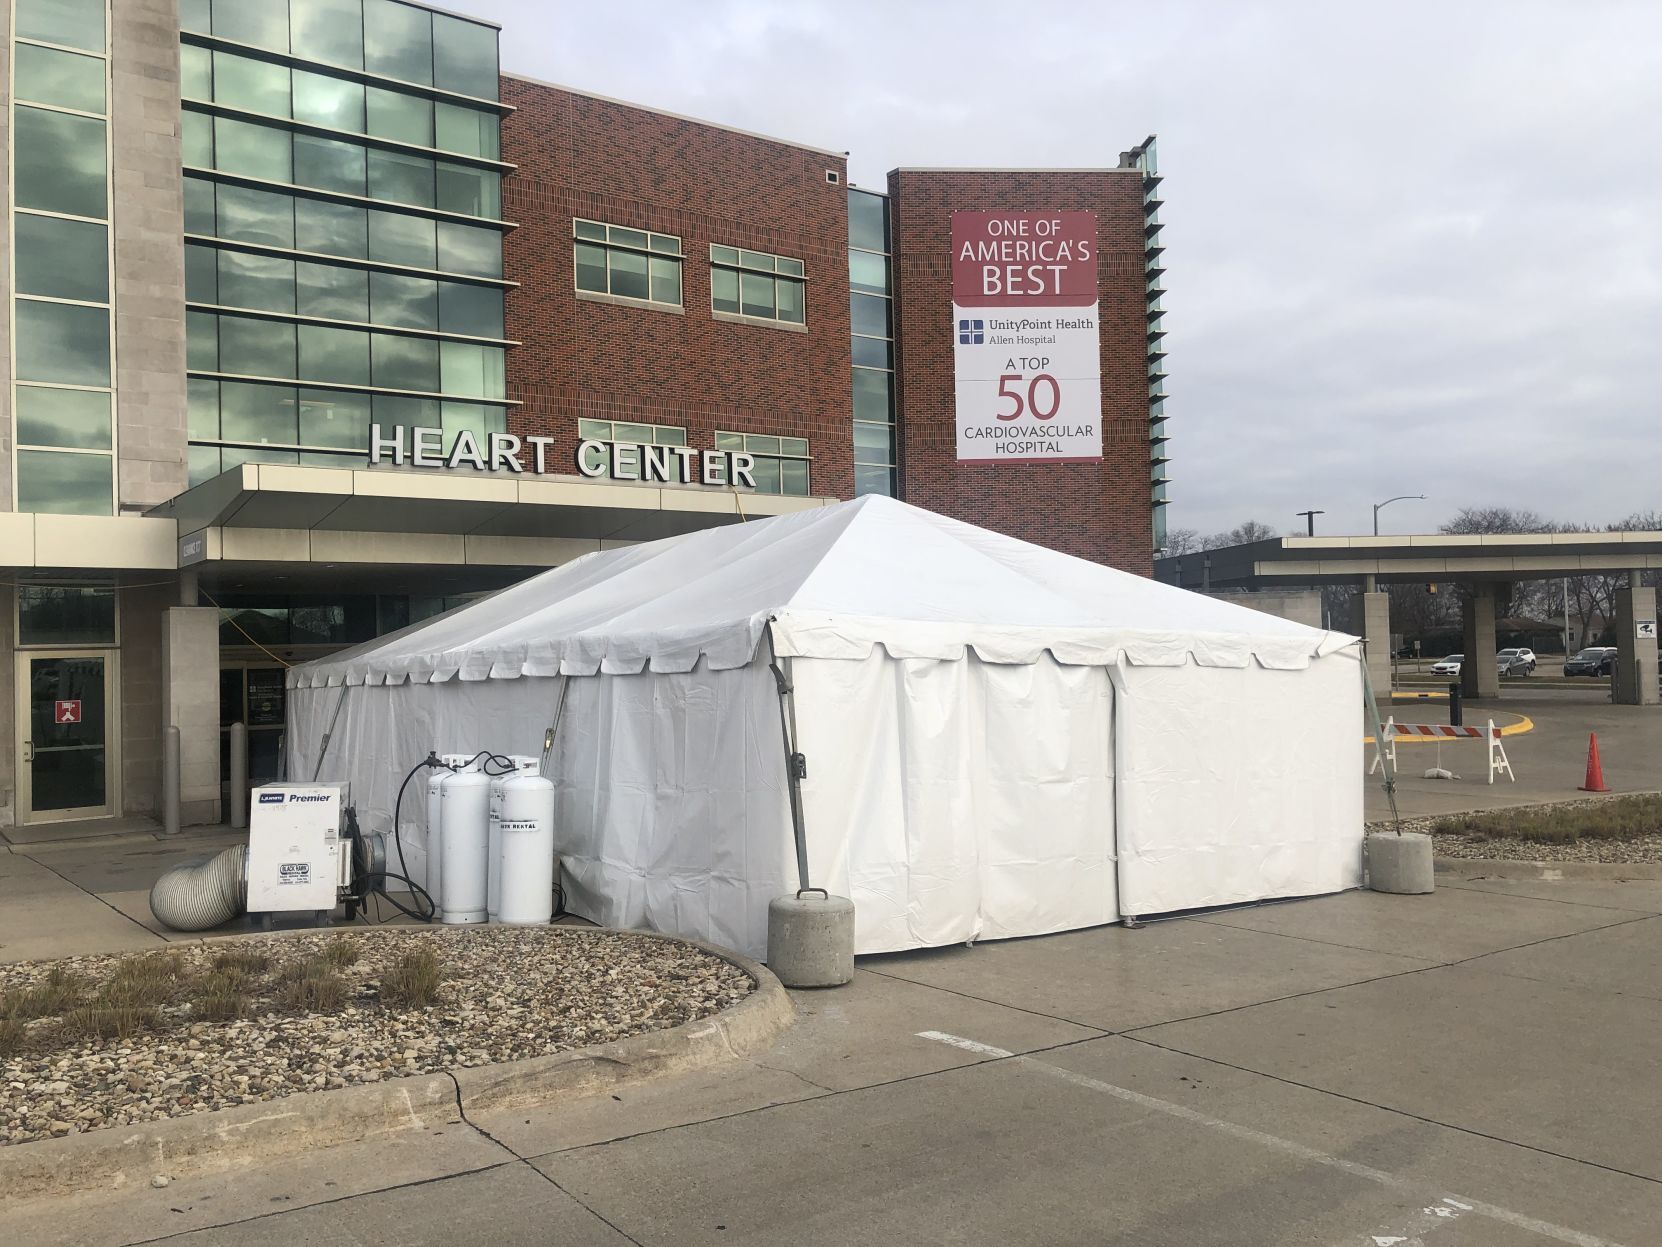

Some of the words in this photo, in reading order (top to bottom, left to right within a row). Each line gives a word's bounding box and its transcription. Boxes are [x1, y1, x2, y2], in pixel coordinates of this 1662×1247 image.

[987, 219, 1029, 236] ONE
[1036, 219, 1061, 236] OF
[959, 240, 1090, 262] AMERICA'S
[983, 265, 1067, 295] BEST
[989, 319, 1052, 332] UnityPoint
[1056, 318, 1094, 329] Health
[989, 336, 1014, 344] Allen
[1016, 335, 1056, 346] Hospital
[1005, 358, 1016, 370] A
[1019, 357, 1050, 370] TOP
[996, 374, 1061, 421] 50
[964, 425, 1094, 439] CARDIOVASCULAR
[995, 441, 1063, 454] HOSPITAL
[369, 423, 555, 474] HEART
[575, 438, 757, 488] CENTER
[289, 794, 331, 803] Premier
